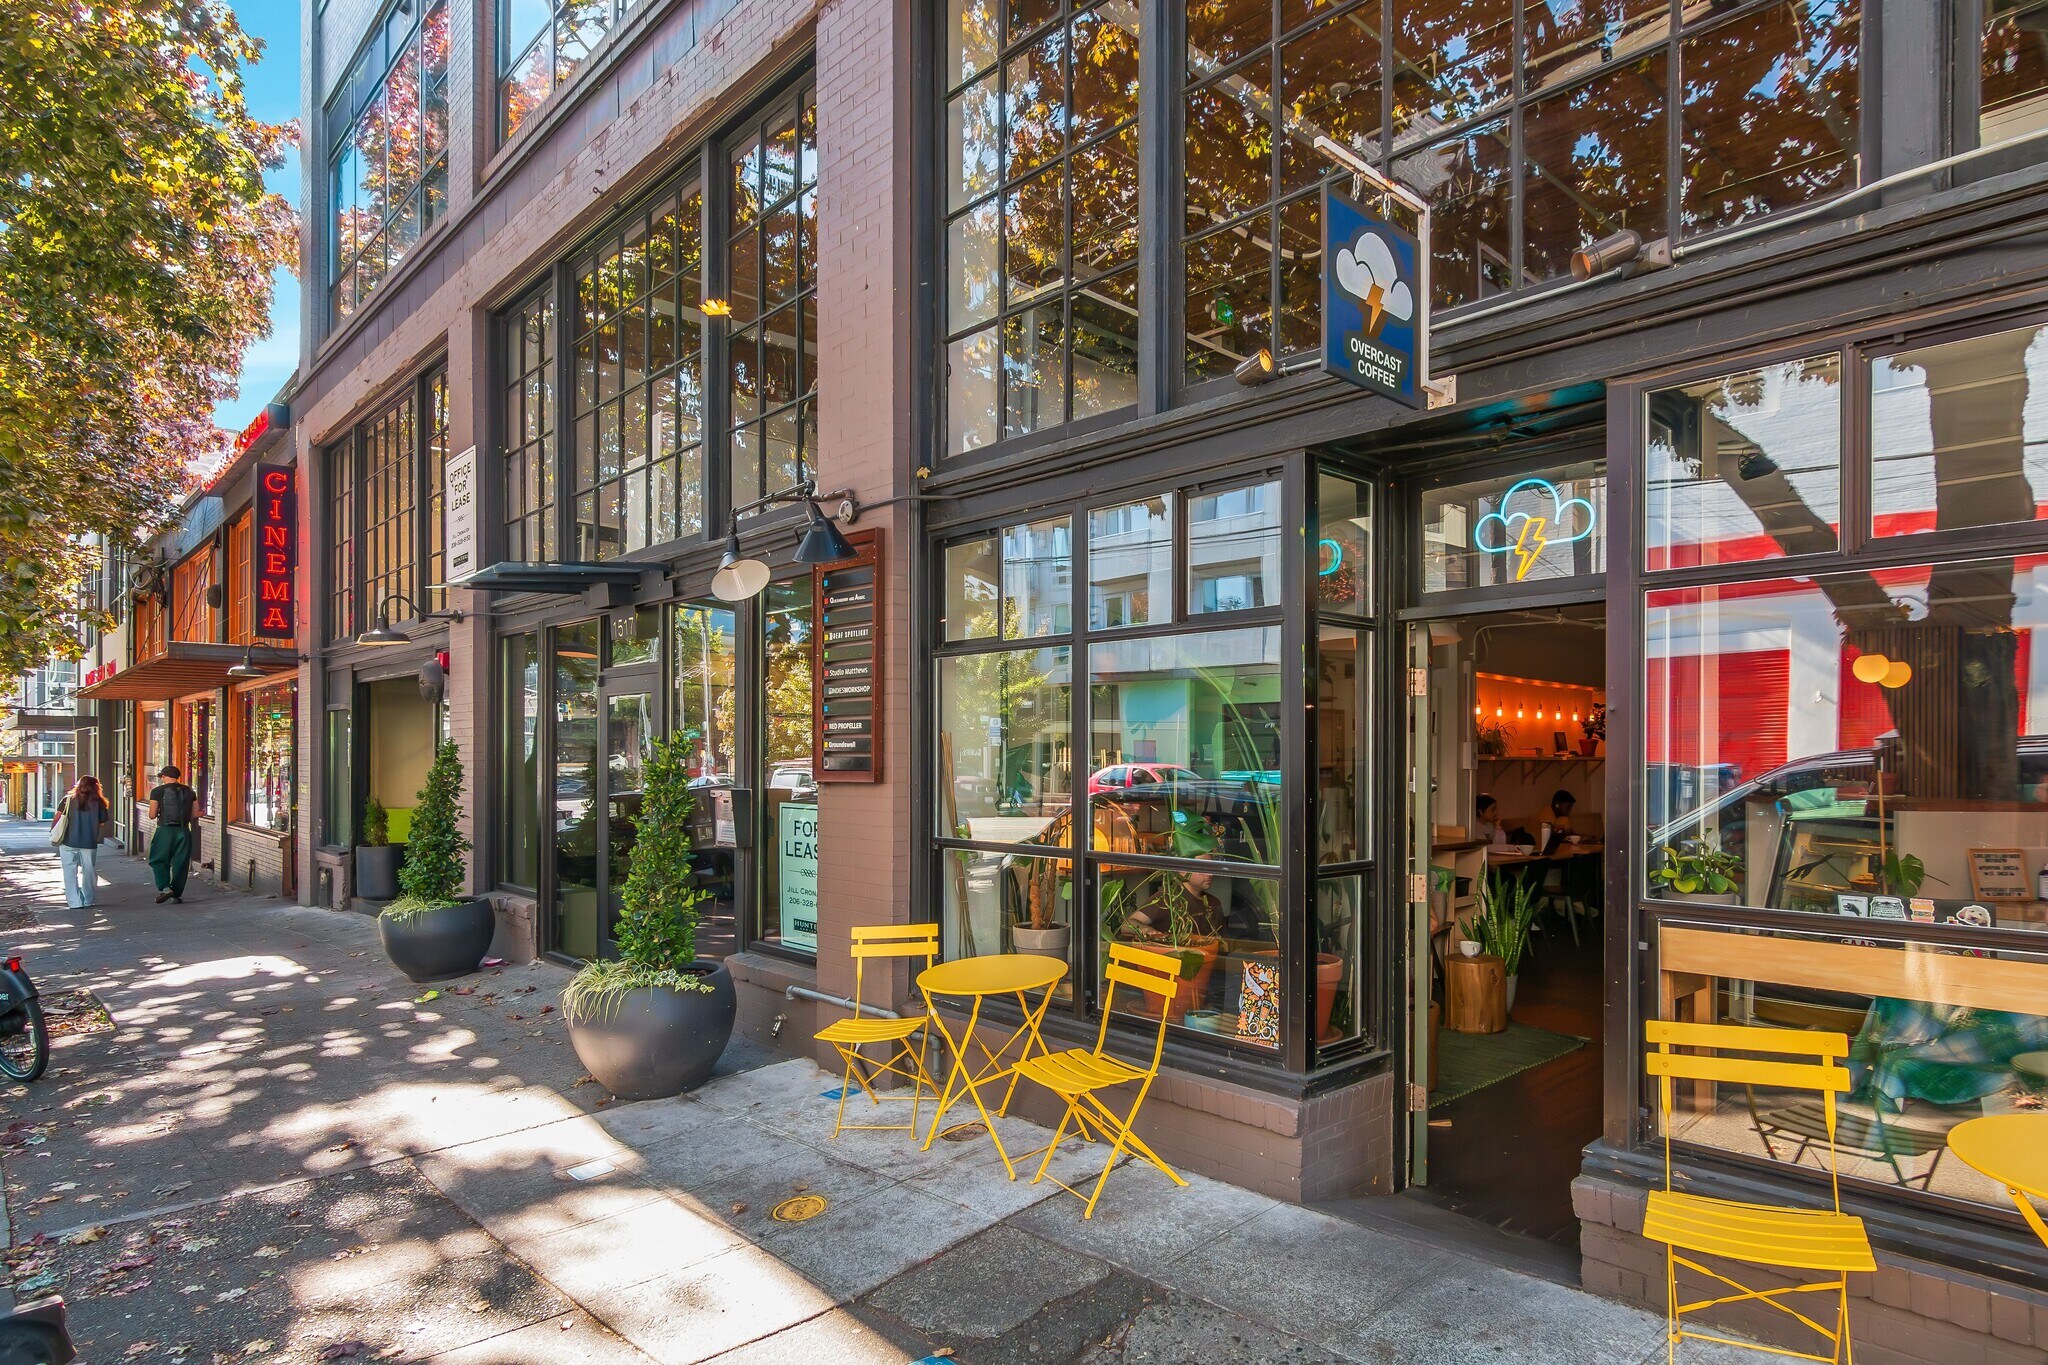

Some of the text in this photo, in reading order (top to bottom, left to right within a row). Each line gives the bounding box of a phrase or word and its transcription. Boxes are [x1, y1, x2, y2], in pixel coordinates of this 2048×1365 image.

[1350, 337, 1402, 373] OVERCAST
[1357, 359, 1396, 388] COFFEE
[450, 462, 471, 483] OFFICE
[454, 480, 466, 495] FOR
[452, 492, 470, 511] LEASE
[262, 471, 290, 628] CINEMA
[612, 616, 634, 637] 1517
[845, 628, 869, 638] SPOTLIGHT
[829, 666, 868, 677] Studio Matthews
[828, 722, 862, 730] RED PROPELLER
[787, 885, 799, 894] JILL
[788, 896, 818, 908] 206-328-
